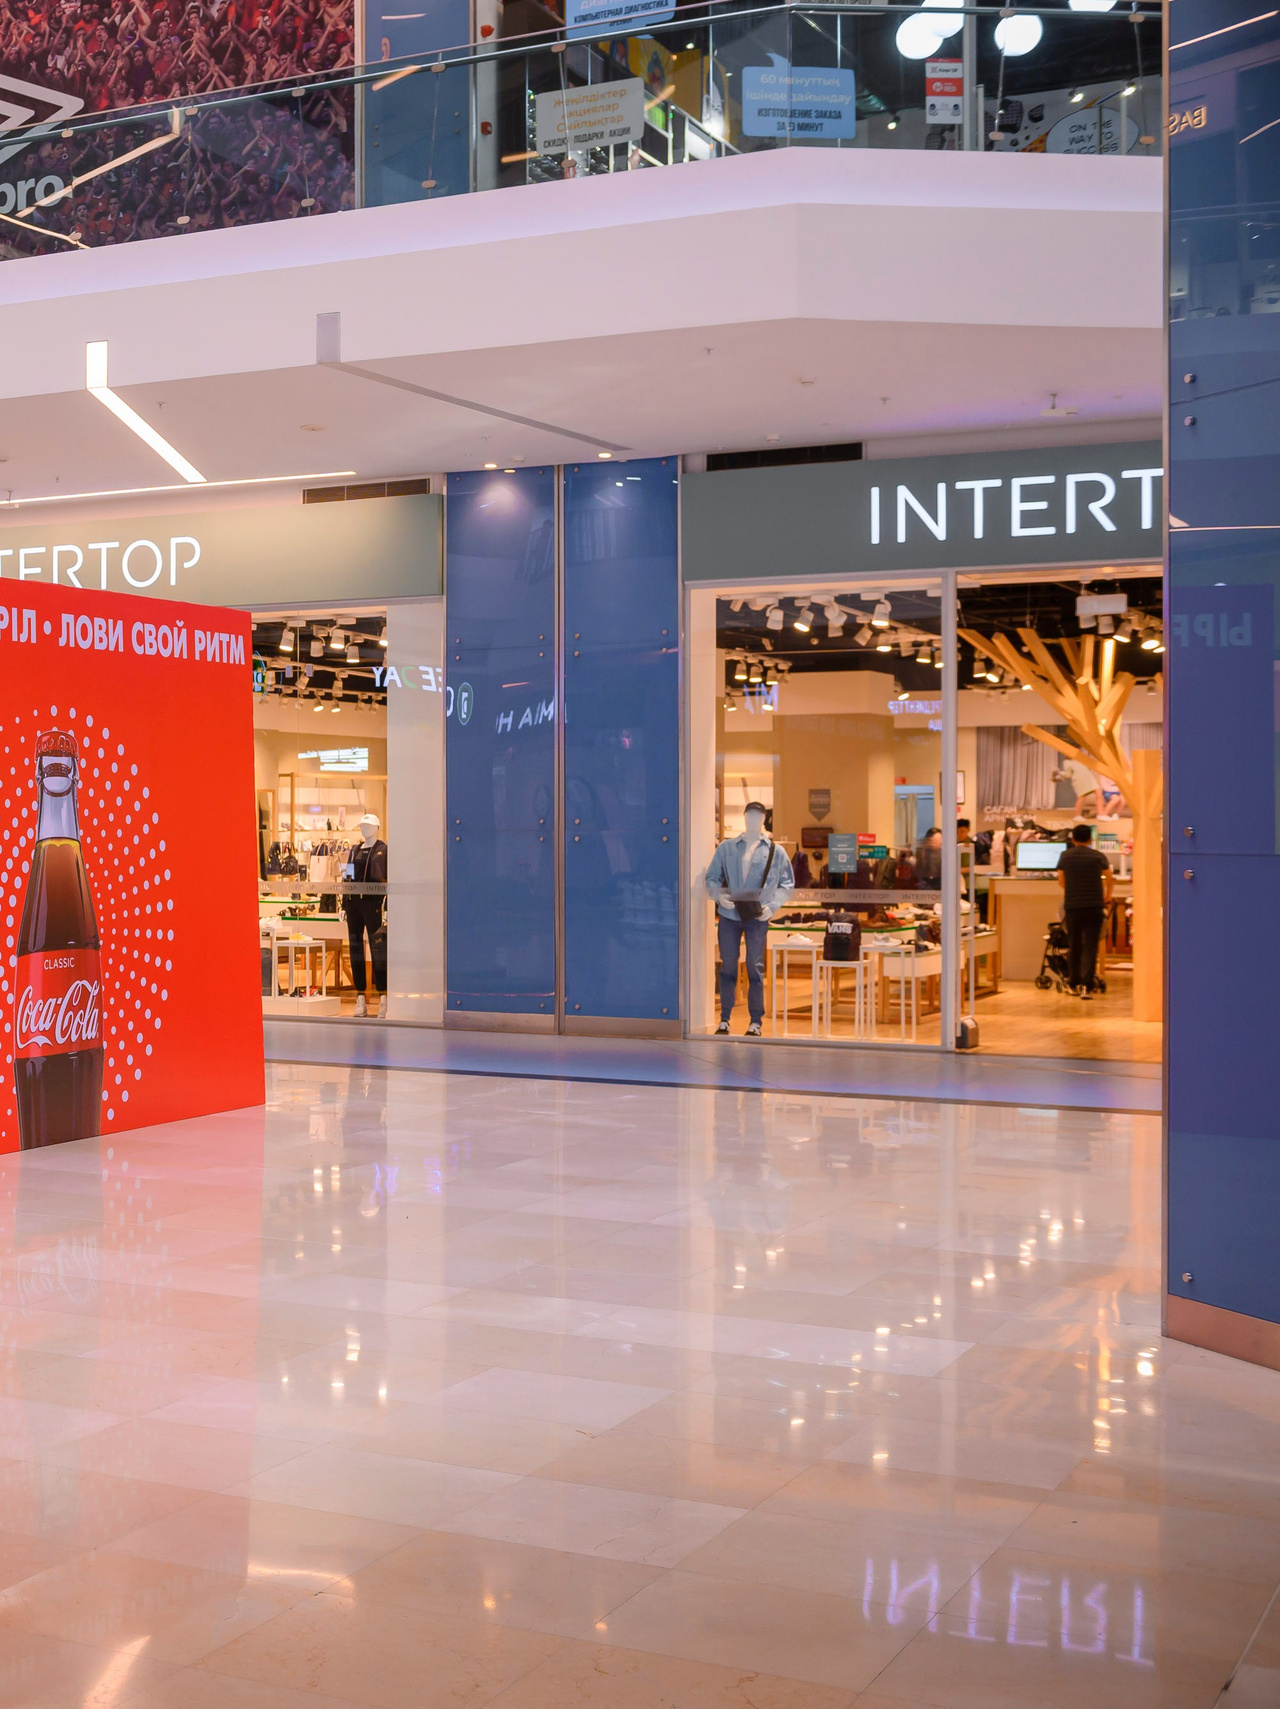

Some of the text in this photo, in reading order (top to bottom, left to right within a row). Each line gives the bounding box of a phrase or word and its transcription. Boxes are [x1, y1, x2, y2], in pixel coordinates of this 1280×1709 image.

[814, 109, 842, 120] ЗАКАЗА
[797, 122, 824, 132] МИНУТ
[1069, 124, 1087, 134] ON
[543, 134, 569, 149] СКИДК
[1069, 134, 1094, 146] WAY
[1063, 142, 1119, 154] CCSS
[58, 612, 123, 653] ЛОВИ
[131, 619, 188, 659] СВОЙ
[194, 633, 246, 666] РИТМ
[828, 921, 853, 935] VANS
[43, 957, 75, 970] CLASSIC
[16, 979, 101, 1049] Coca-Cola
